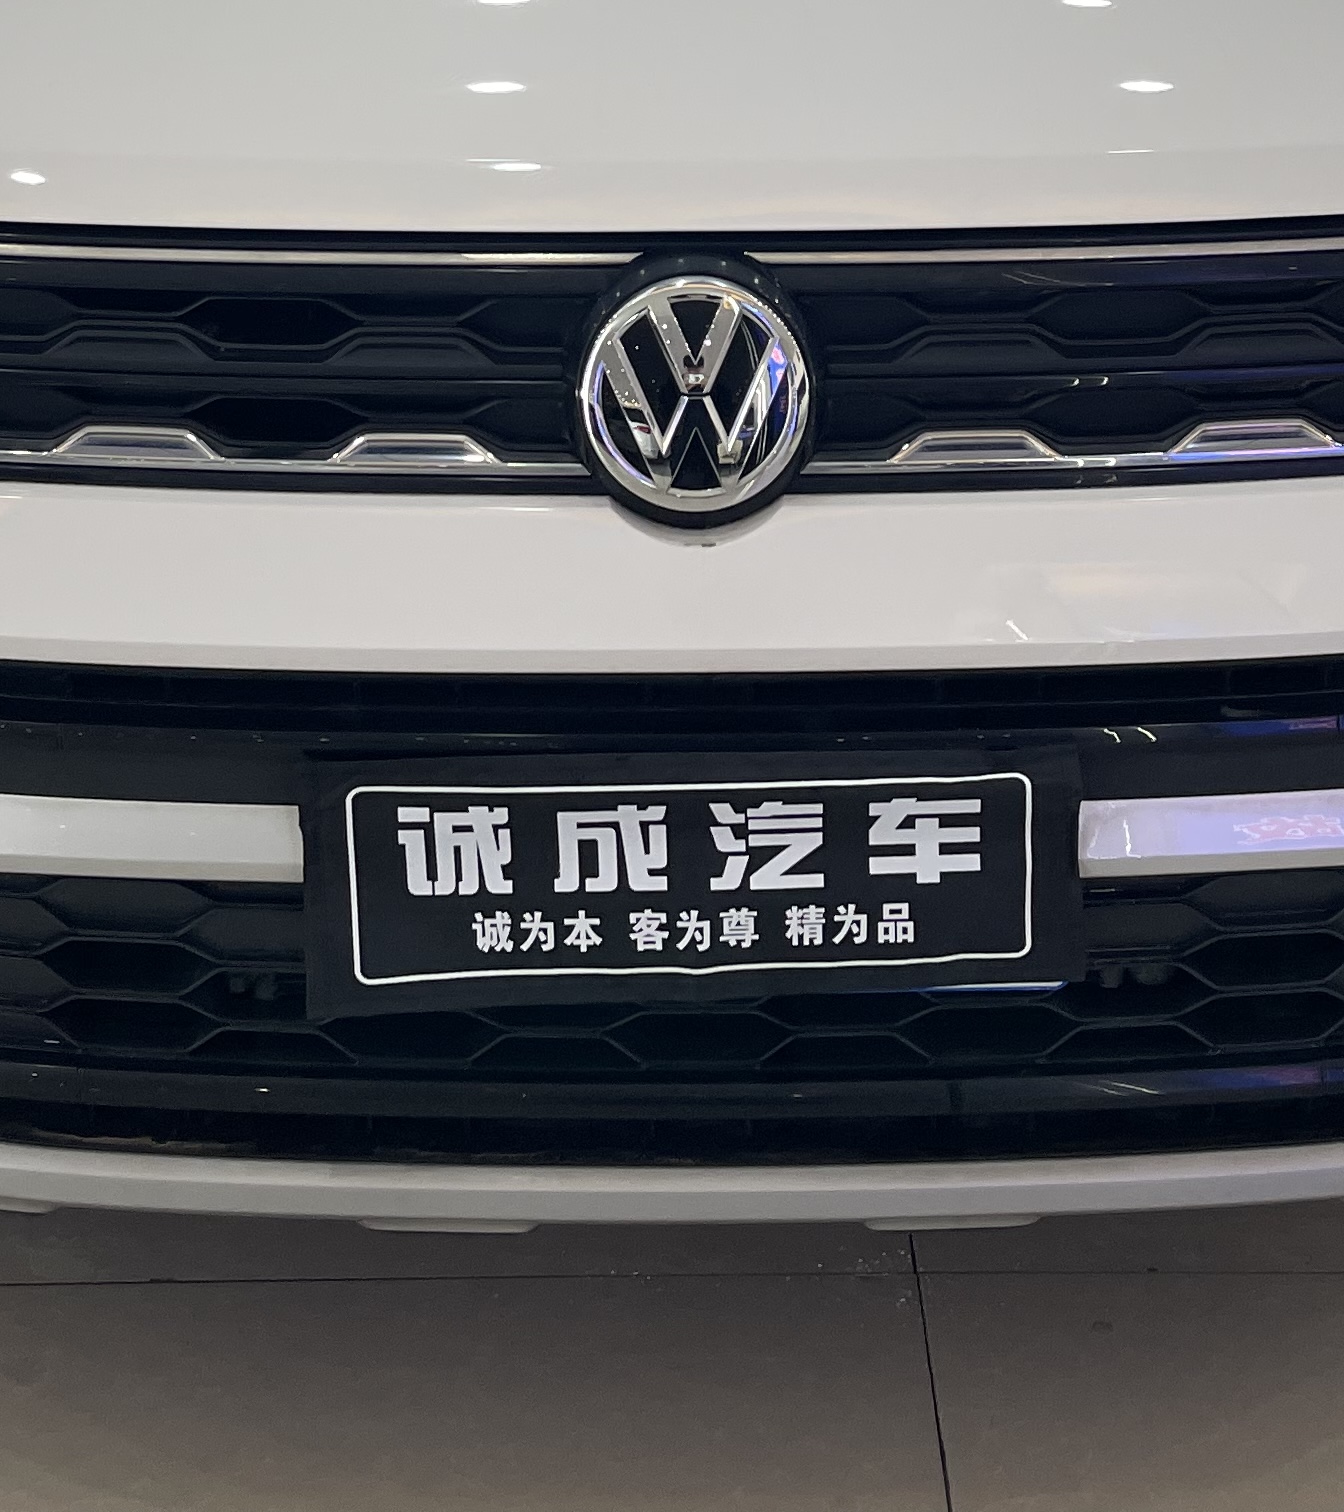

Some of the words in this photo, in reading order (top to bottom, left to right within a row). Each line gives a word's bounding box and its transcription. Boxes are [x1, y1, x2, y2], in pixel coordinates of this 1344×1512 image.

[396, 797, 983, 897] 诚成汽车
[472, 909, 604, 953] 诚为本
[629, 906, 760, 953] 客为尊
[784, 901, 916, 947] 精为品
